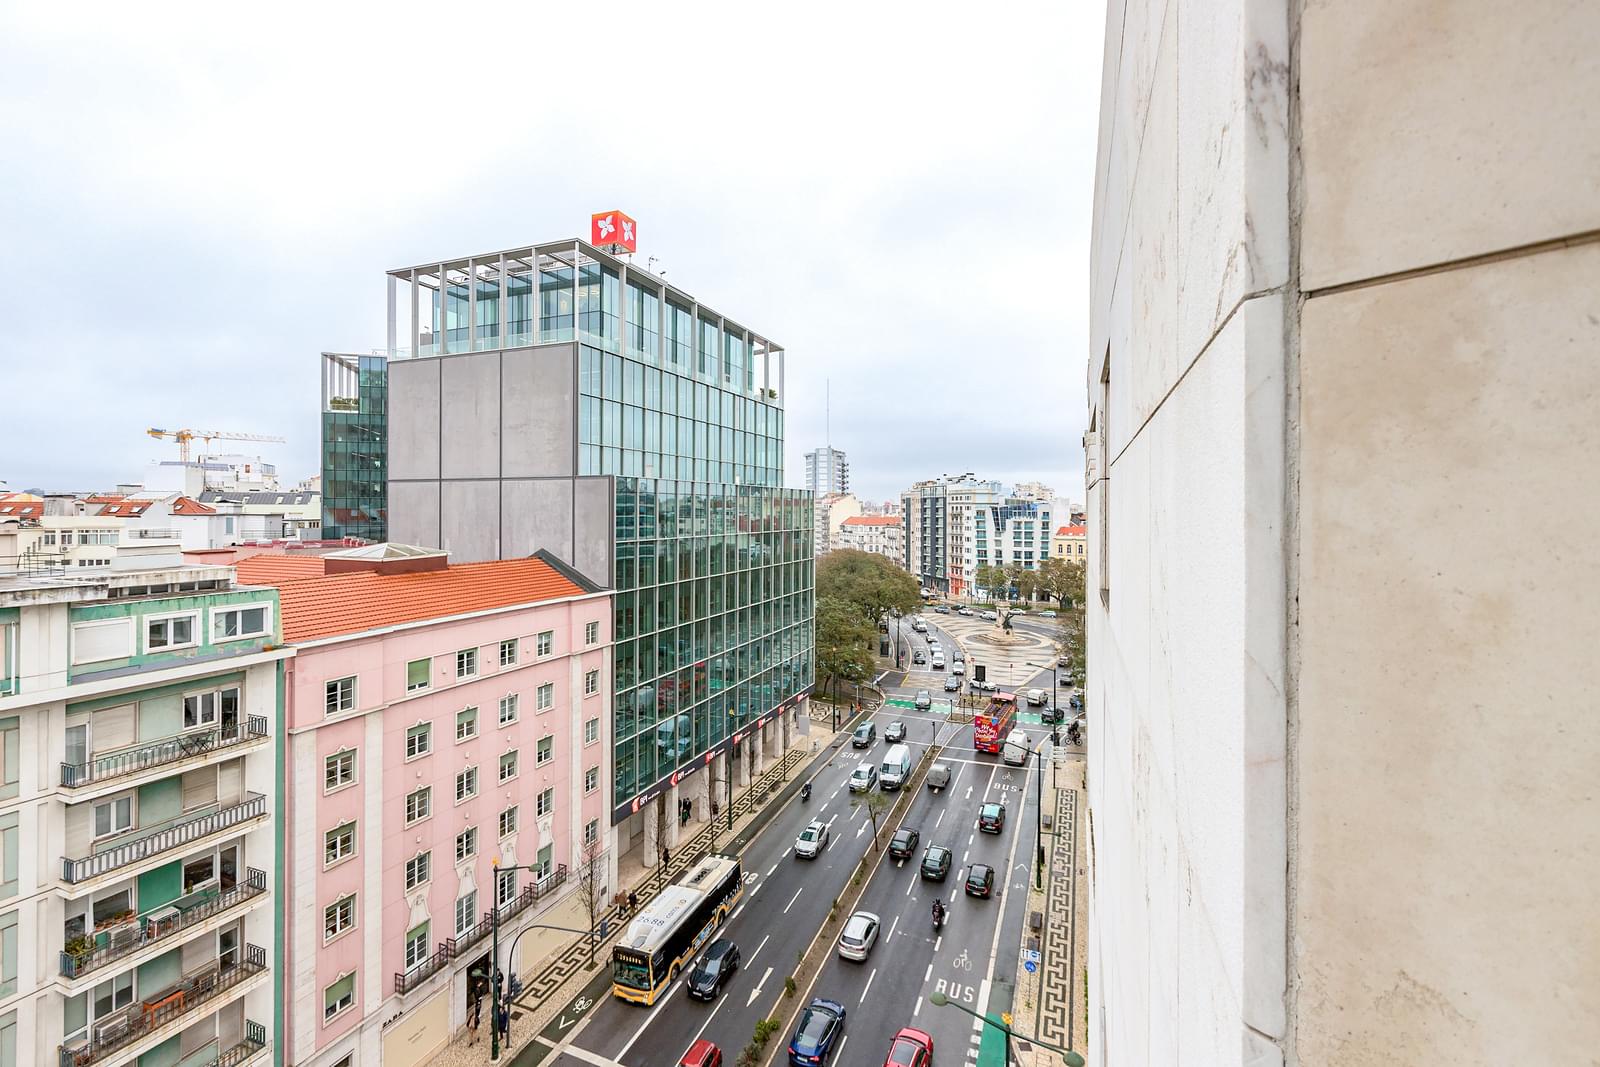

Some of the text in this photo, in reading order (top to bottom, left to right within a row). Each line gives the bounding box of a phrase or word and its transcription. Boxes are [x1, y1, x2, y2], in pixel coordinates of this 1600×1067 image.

[840, 751, 861, 760] BUS
[993, 782, 1018, 793] BUS
[640, 794, 648, 806] BPI
[382, 1011, 403, 1029] ZARA
